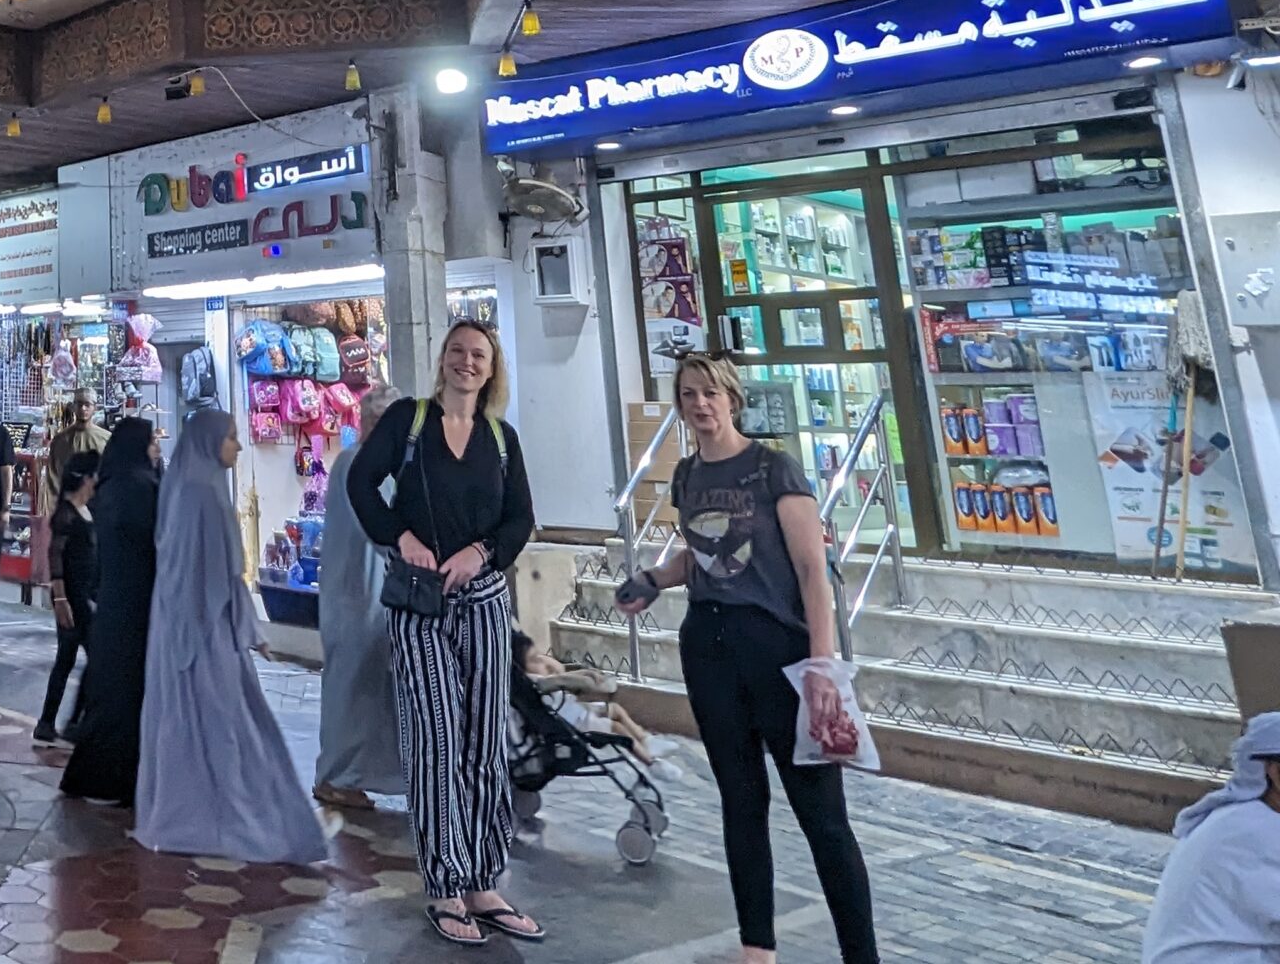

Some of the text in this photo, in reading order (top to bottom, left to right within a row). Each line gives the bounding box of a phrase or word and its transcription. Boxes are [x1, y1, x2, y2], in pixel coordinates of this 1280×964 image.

[833, 20, 979, 65] مسقط
[485, 63, 741, 126] Muscat Pharmacy
[736, 87, 753, 99] LLC
[253, 145, 357, 191] أسواق
[153, 223, 242, 253] Shopping center
